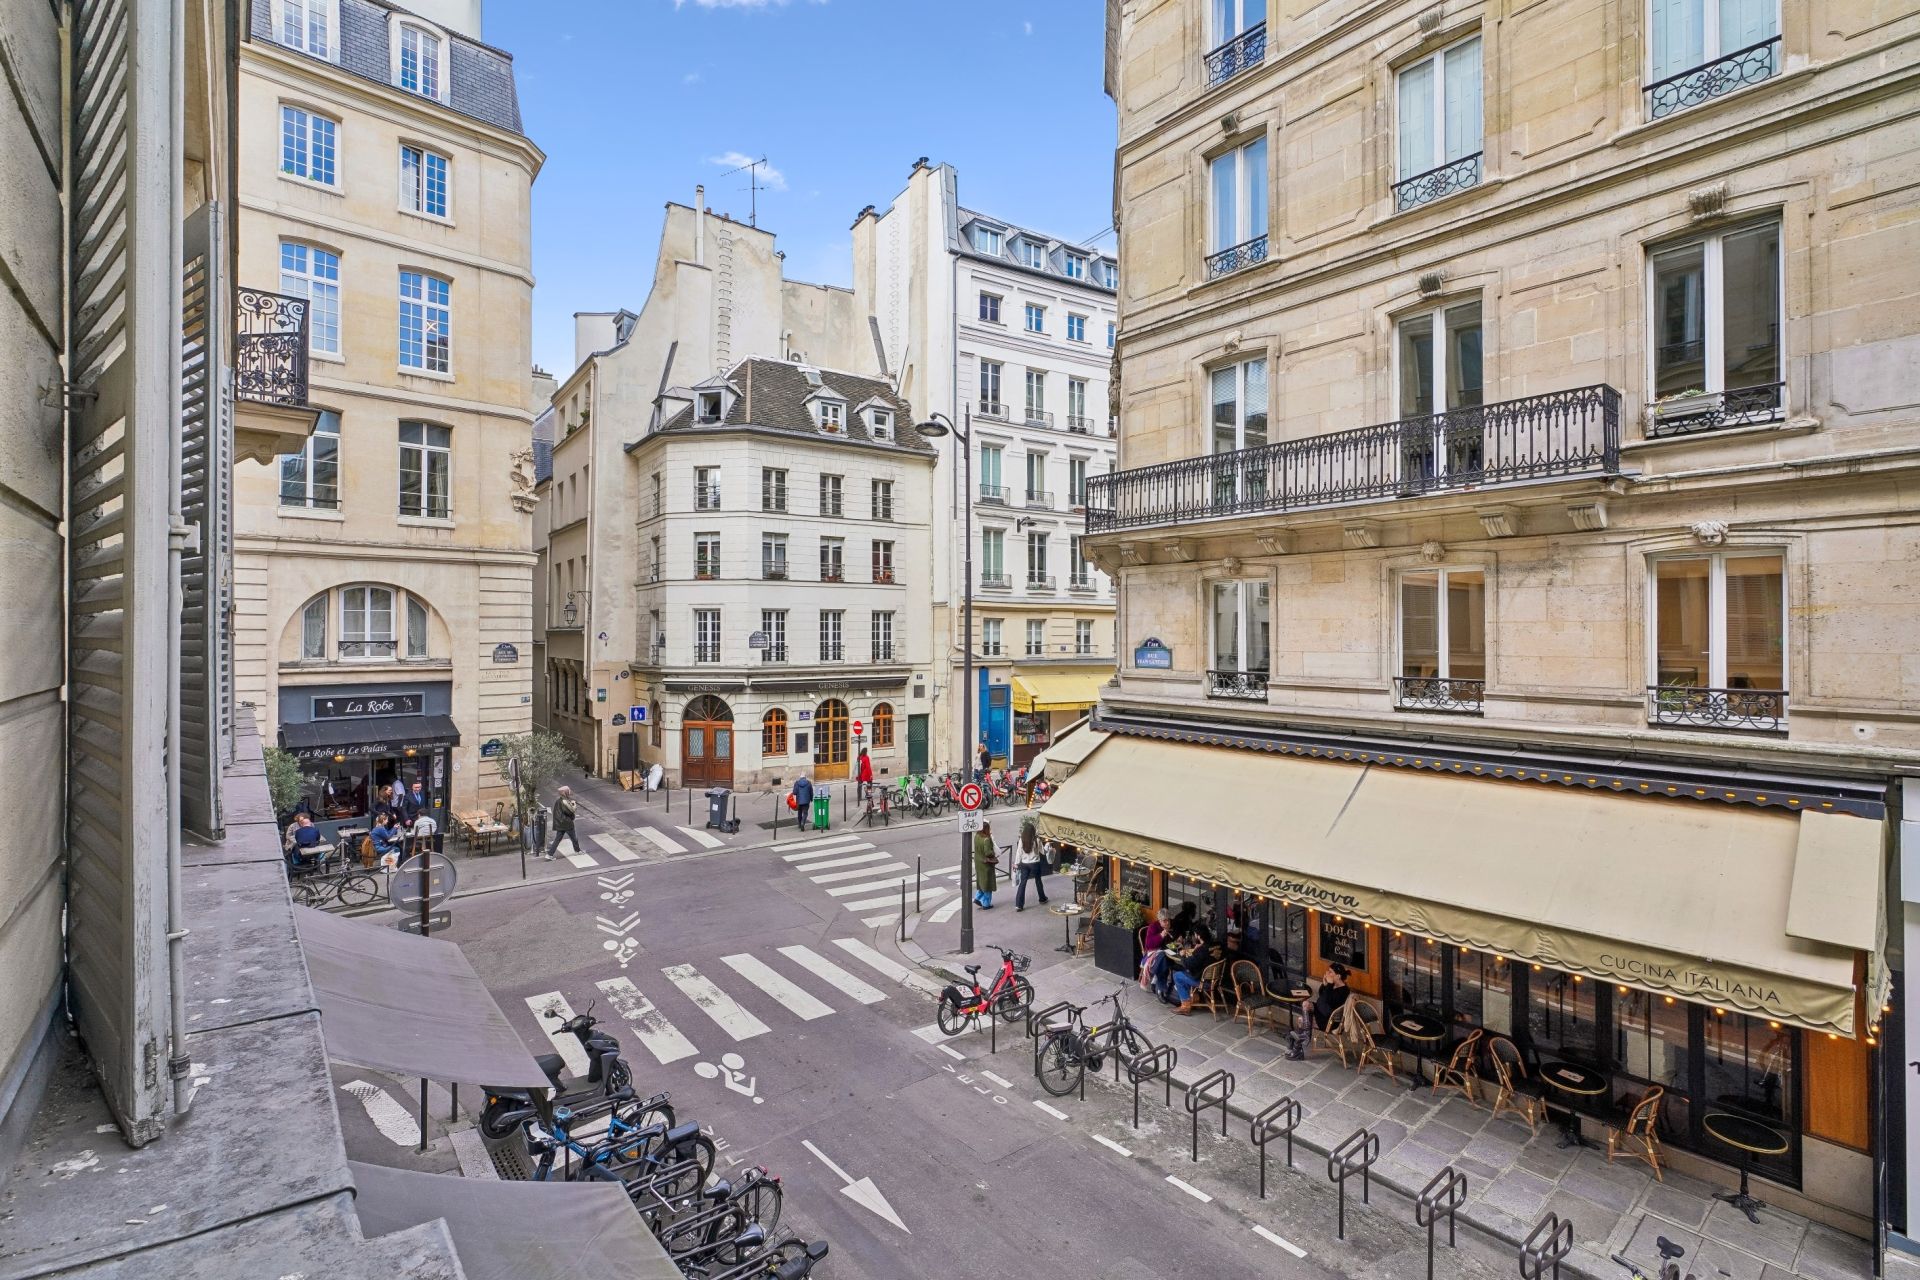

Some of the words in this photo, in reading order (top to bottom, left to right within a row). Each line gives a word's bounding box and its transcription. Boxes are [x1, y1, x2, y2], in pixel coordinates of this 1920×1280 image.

[819, 681, 849, 689] GENESIS
[345, 702, 363, 713] La
[368, 700, 394, 713] Robe
[298, 750, 310, 758] La
[312, 748, 334, 757] Robe
[336, 747, 345, 755] et
[347, 746, 359, 754] Le
[361, 744, 387, 753] Palais
[1057, 826, 1076, 837] PIZZA
[1080, 831, 1102, 843] PASTA
[1265, 874, 1359, 907] Casanova
[1325, 923, 1358, 940] DOLCI
[1600, 954, 1677, 981] CUCINA
[1684, 971, 1781, 1005] ITALIANA
[941, 1064, 1008, 1104] VELO
